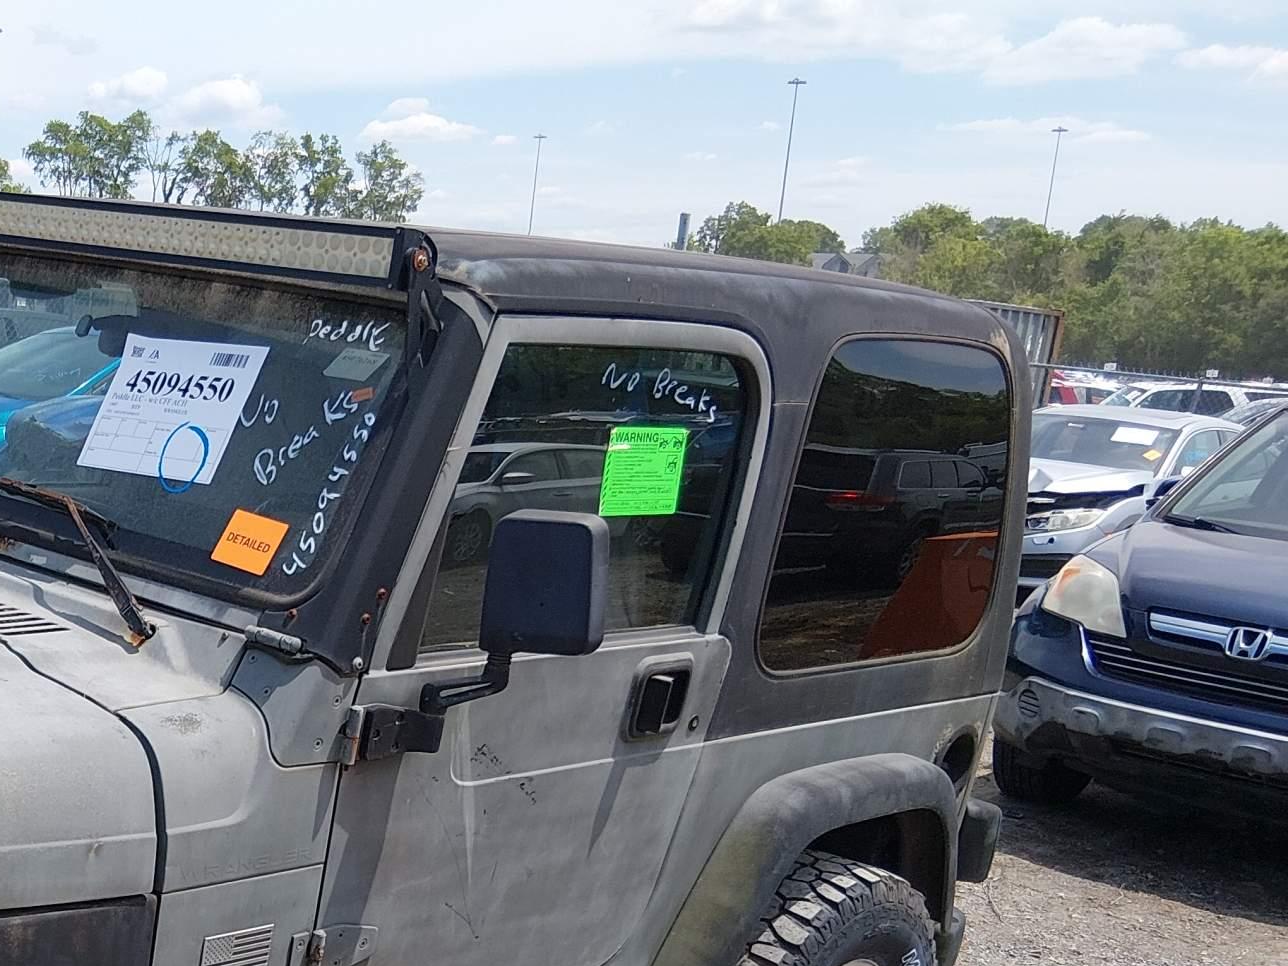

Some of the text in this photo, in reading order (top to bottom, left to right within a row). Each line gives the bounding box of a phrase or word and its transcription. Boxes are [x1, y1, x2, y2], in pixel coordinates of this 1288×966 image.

[125, 368, 236, 403] 45094550
[614, 431, 659, 443] WARNING
[281, 411, 376, 576] 45094550
[225, 530, 271, 554] DETAILED
